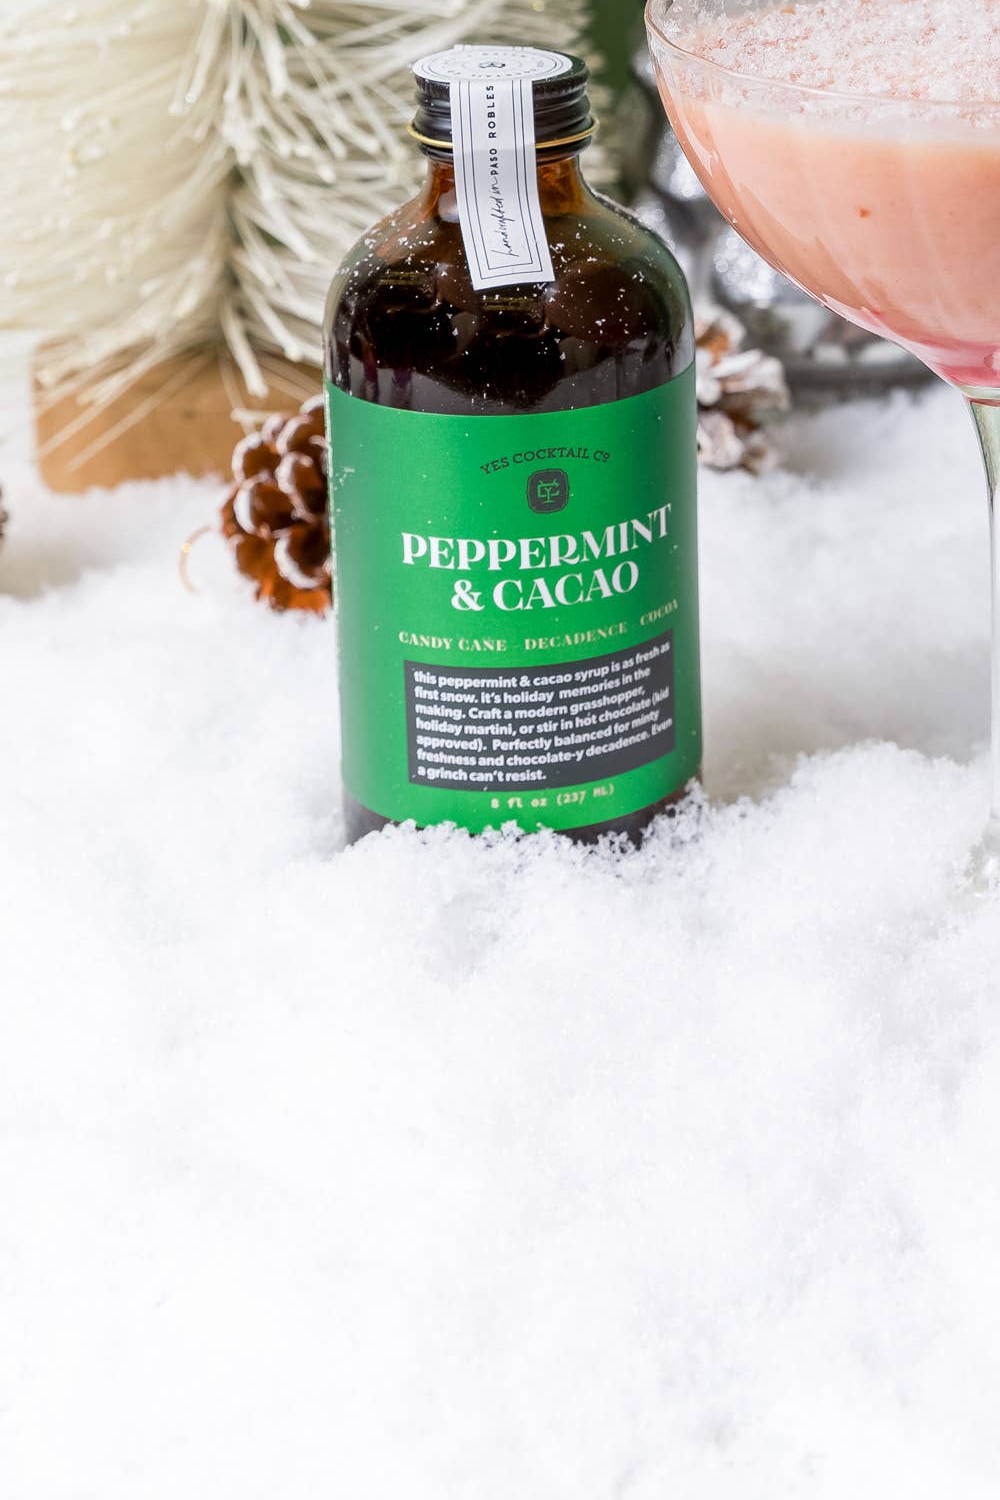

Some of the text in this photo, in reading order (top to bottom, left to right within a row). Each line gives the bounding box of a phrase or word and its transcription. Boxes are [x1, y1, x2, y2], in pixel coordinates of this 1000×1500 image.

[486, 84, 498, 139] ROBLES
[489, 148, 500, 176] PASO
[480, 456, 510, 475] YES
[512, 446, 590, 464] COCKTAIL
[401, 503, 672, 571] PEPPERMINT
[450, 560, 640, 612] & CACAO
[398, 598, 680, 652] CANDY CANE DECADENCE COCOA
[413, 641, 671, 690] this peppermint & cacao syrup is as fresh as
[413, 685, 440, 702] first
[439, 691, 479, 704] snow.
[503, 688, 555, 705] holiday
[558, 677, 621, 700] memories
[621, 673, 633, 686] in
[633, 666, 652, 681] the
[414, 685, 646, 721] making. Craft a modern grasshopper,
[415, 685, 670, 737] holiday martini, or stir in hot chocolate (kid
[415, 709, 661, 753] approved). Perfectly balanced for minty
[416, 717, 674, 767] freshness and chocolate-y decadence. Even
[416, 765, 548, 783] a grinch can't resist.
[490, 783, 615, 809] 8 fl oz (237 ML)
